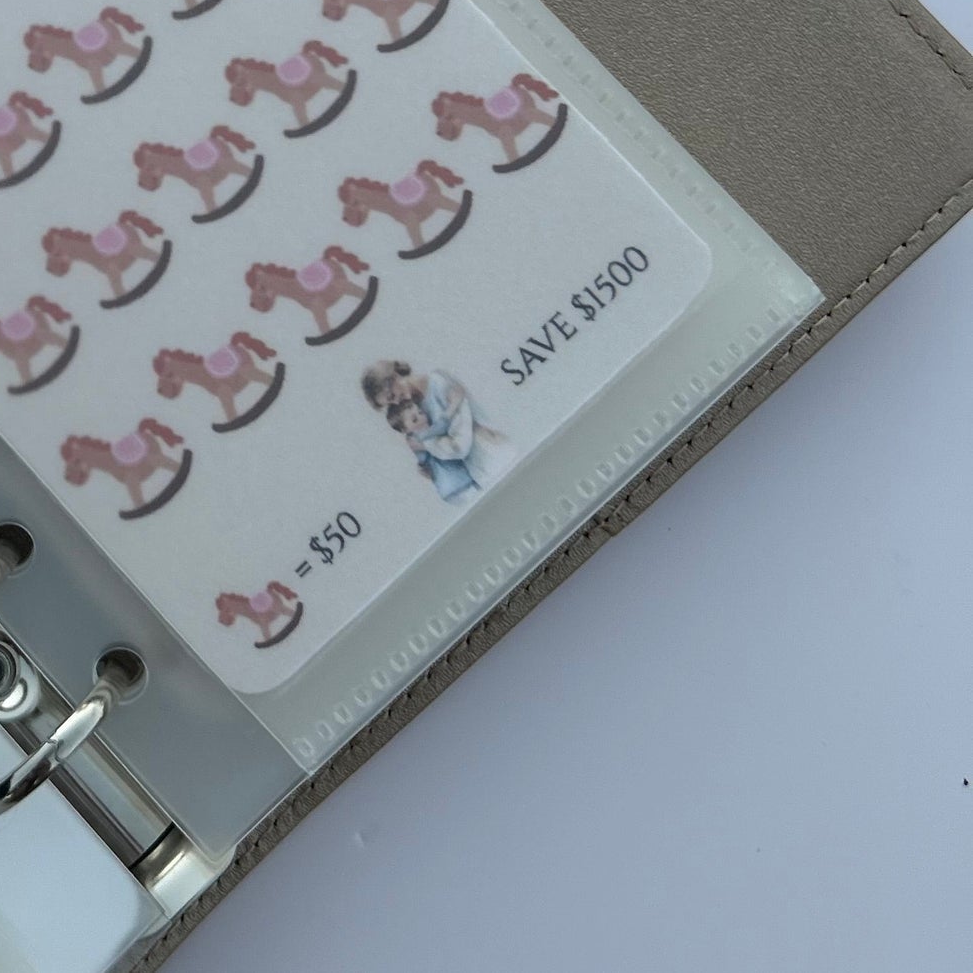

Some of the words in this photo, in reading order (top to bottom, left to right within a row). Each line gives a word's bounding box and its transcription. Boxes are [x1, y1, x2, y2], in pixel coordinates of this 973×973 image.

[500, 310, 578, 387] SAVE
[570, 245, 650, 322] $1500
[308, 510, 363, 565] $50
